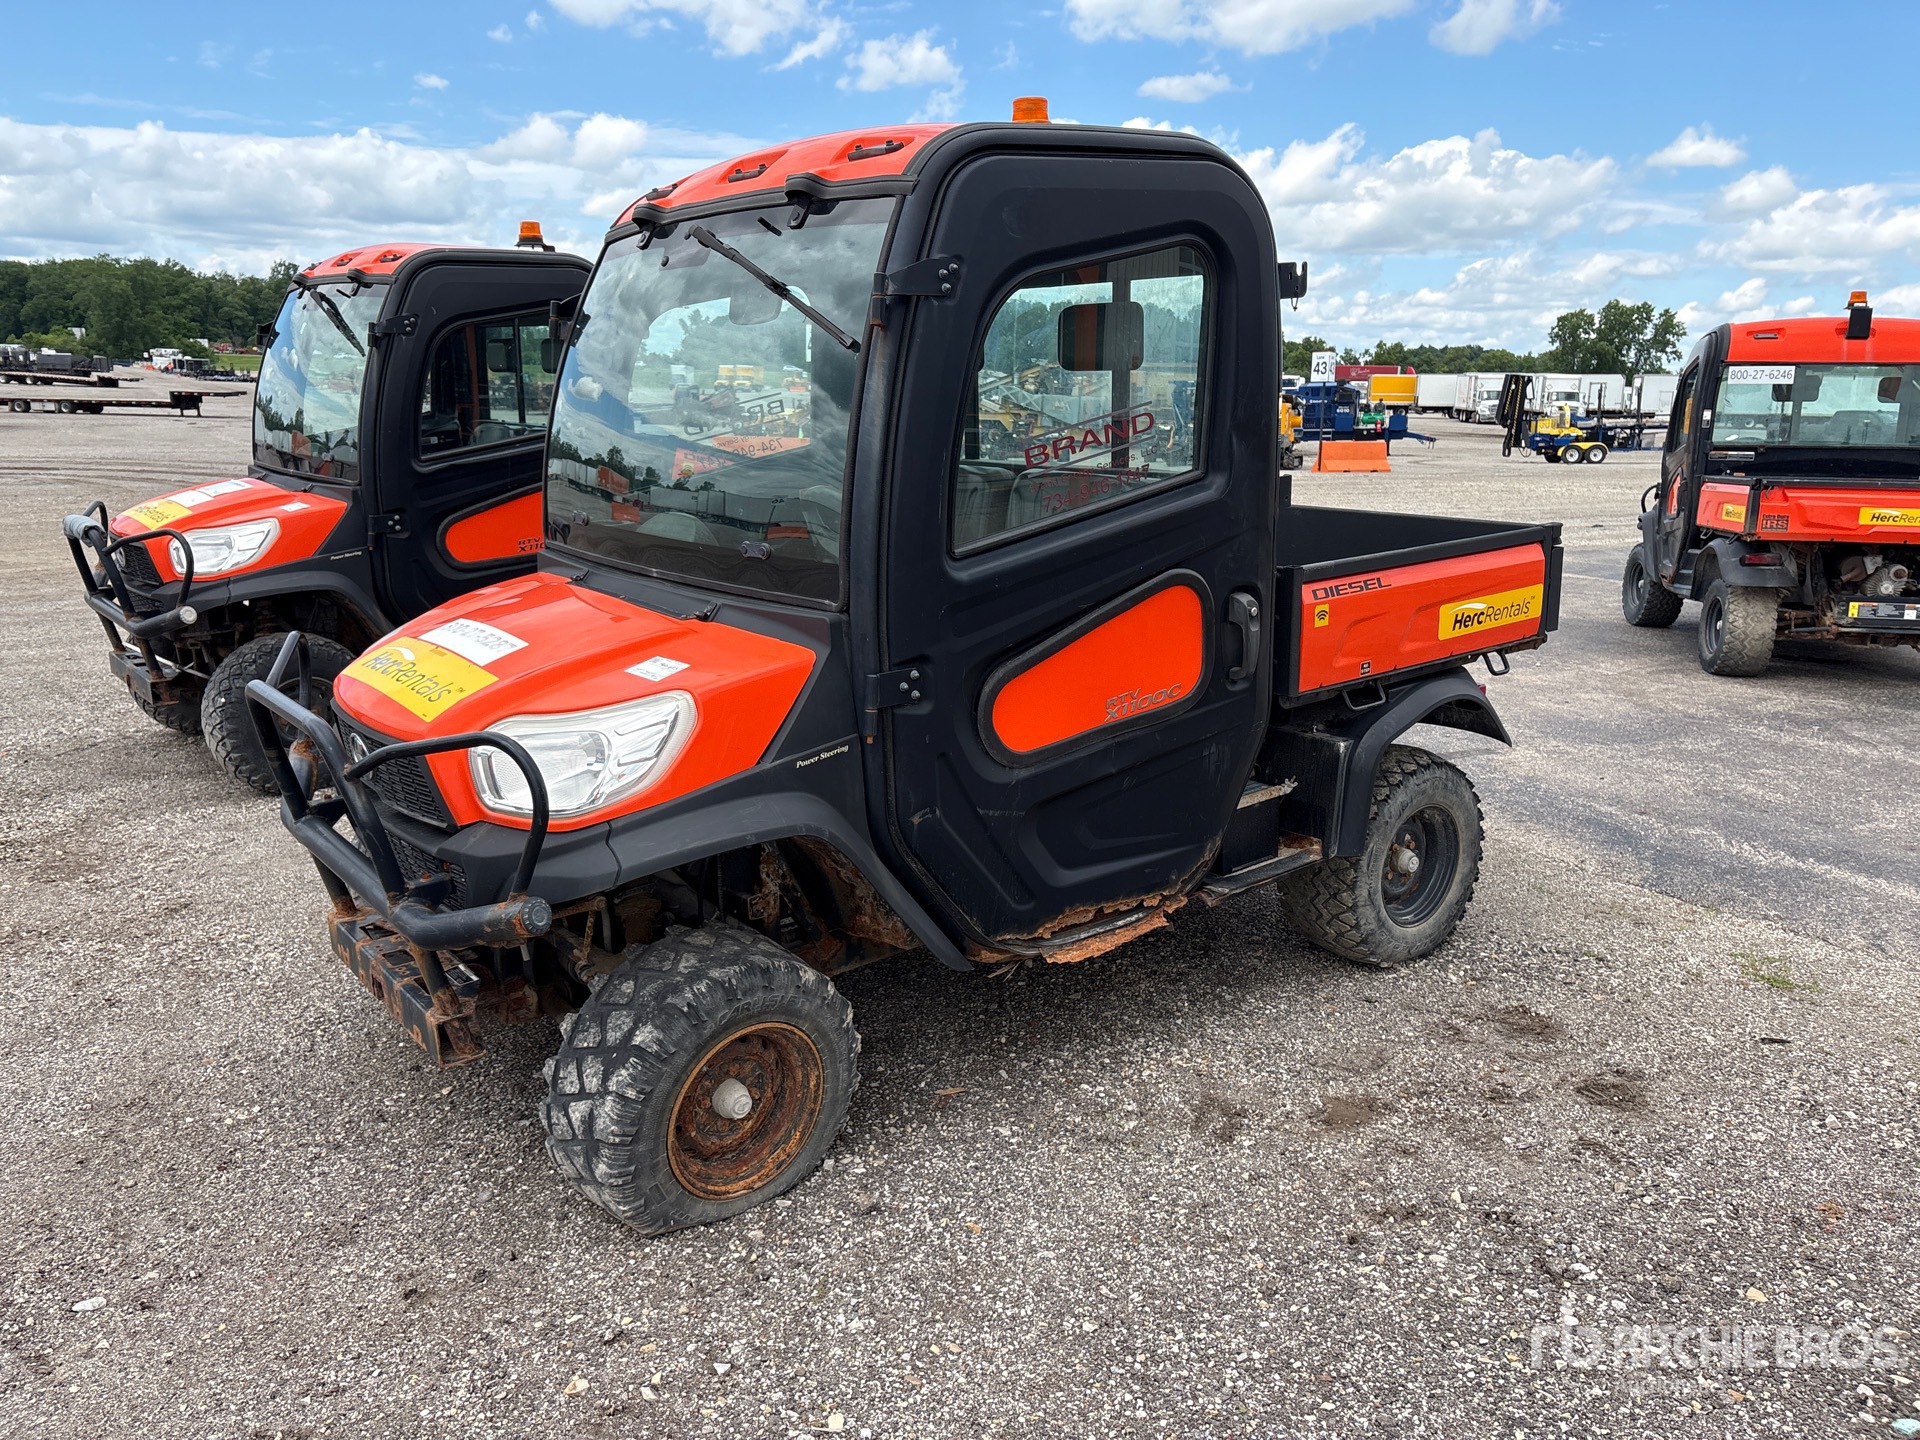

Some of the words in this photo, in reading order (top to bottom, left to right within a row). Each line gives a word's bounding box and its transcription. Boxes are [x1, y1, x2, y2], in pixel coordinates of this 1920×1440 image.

[1313, 361, 1328, 375] 43
[1730, 369, 1793, 380] 800-27-6246
[1024, 412, 1155, 469] BRAND
[1140, 445, 1157, 458] LLC
[1762, 520, 1788, 529] IRS
[1312, 577, 1392, 601] DIESEL
[1452, 597, 1531, 632] HercRentals
[362, 651, 454, 703] HercRentals
[1104, 683, 1182, 722] X1100C
[1106, 688, 1141, 708] RTV
[796, 755, 820, 769] Power
[820, 745, 849, 760] Steering
